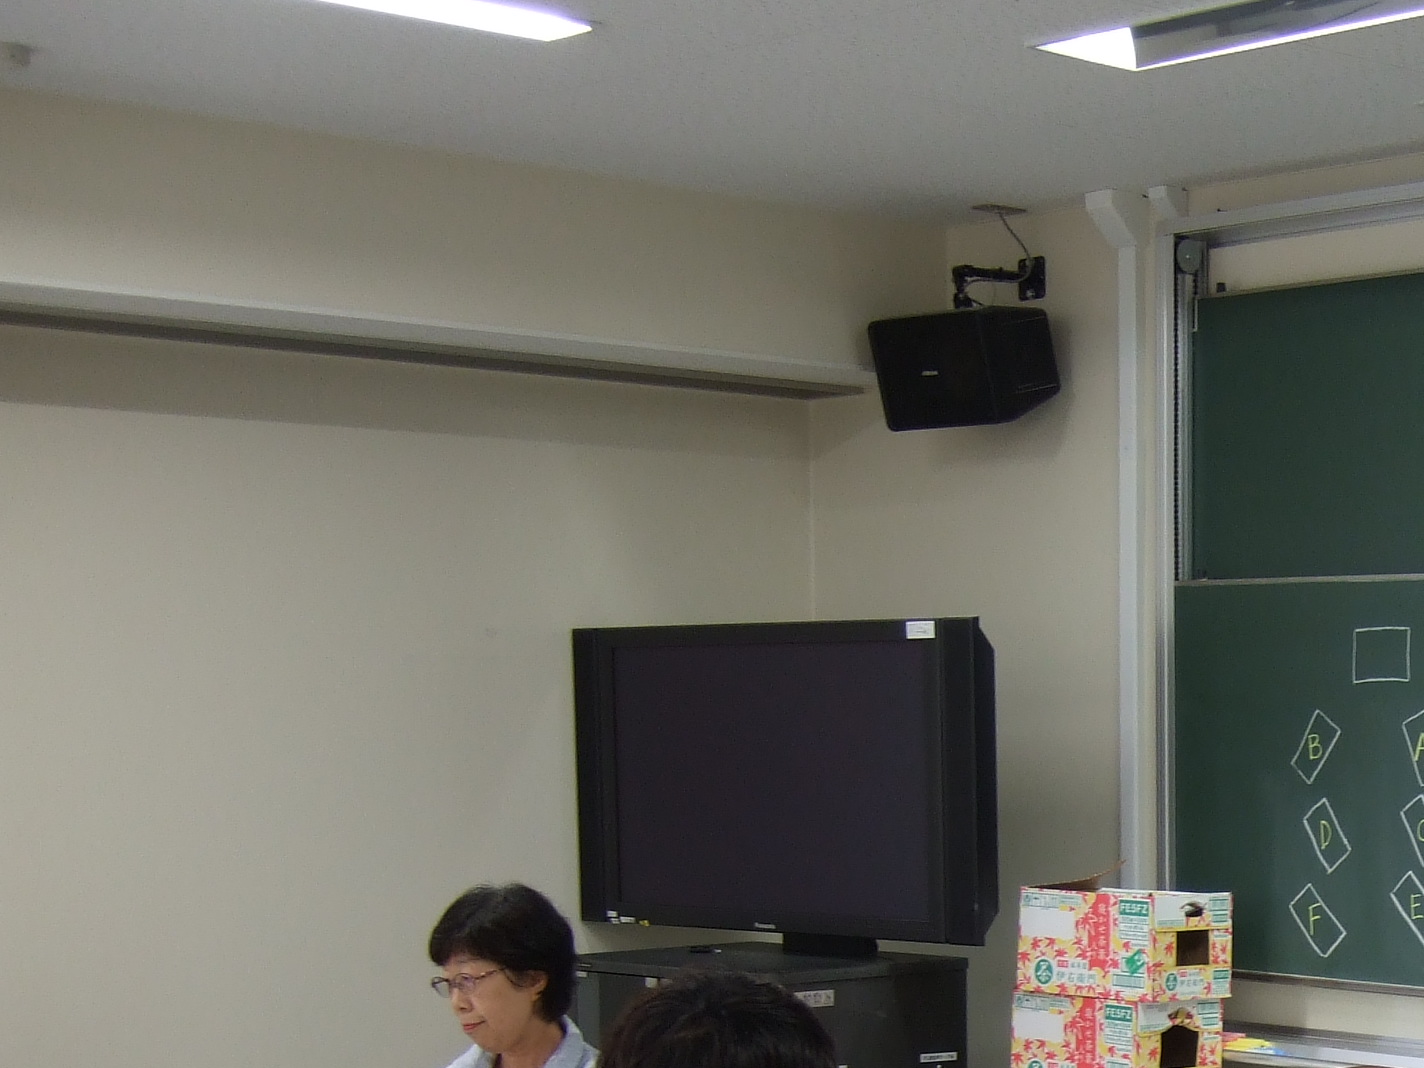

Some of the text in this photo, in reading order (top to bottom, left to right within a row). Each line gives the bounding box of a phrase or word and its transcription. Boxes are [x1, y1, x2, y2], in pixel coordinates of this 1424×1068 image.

[1307, 734, 1323, 760] B
[1319, 820, 1332, 850] D
[1308, 902, 1322, 936] F
[1409, 893, 1424, 920] E
